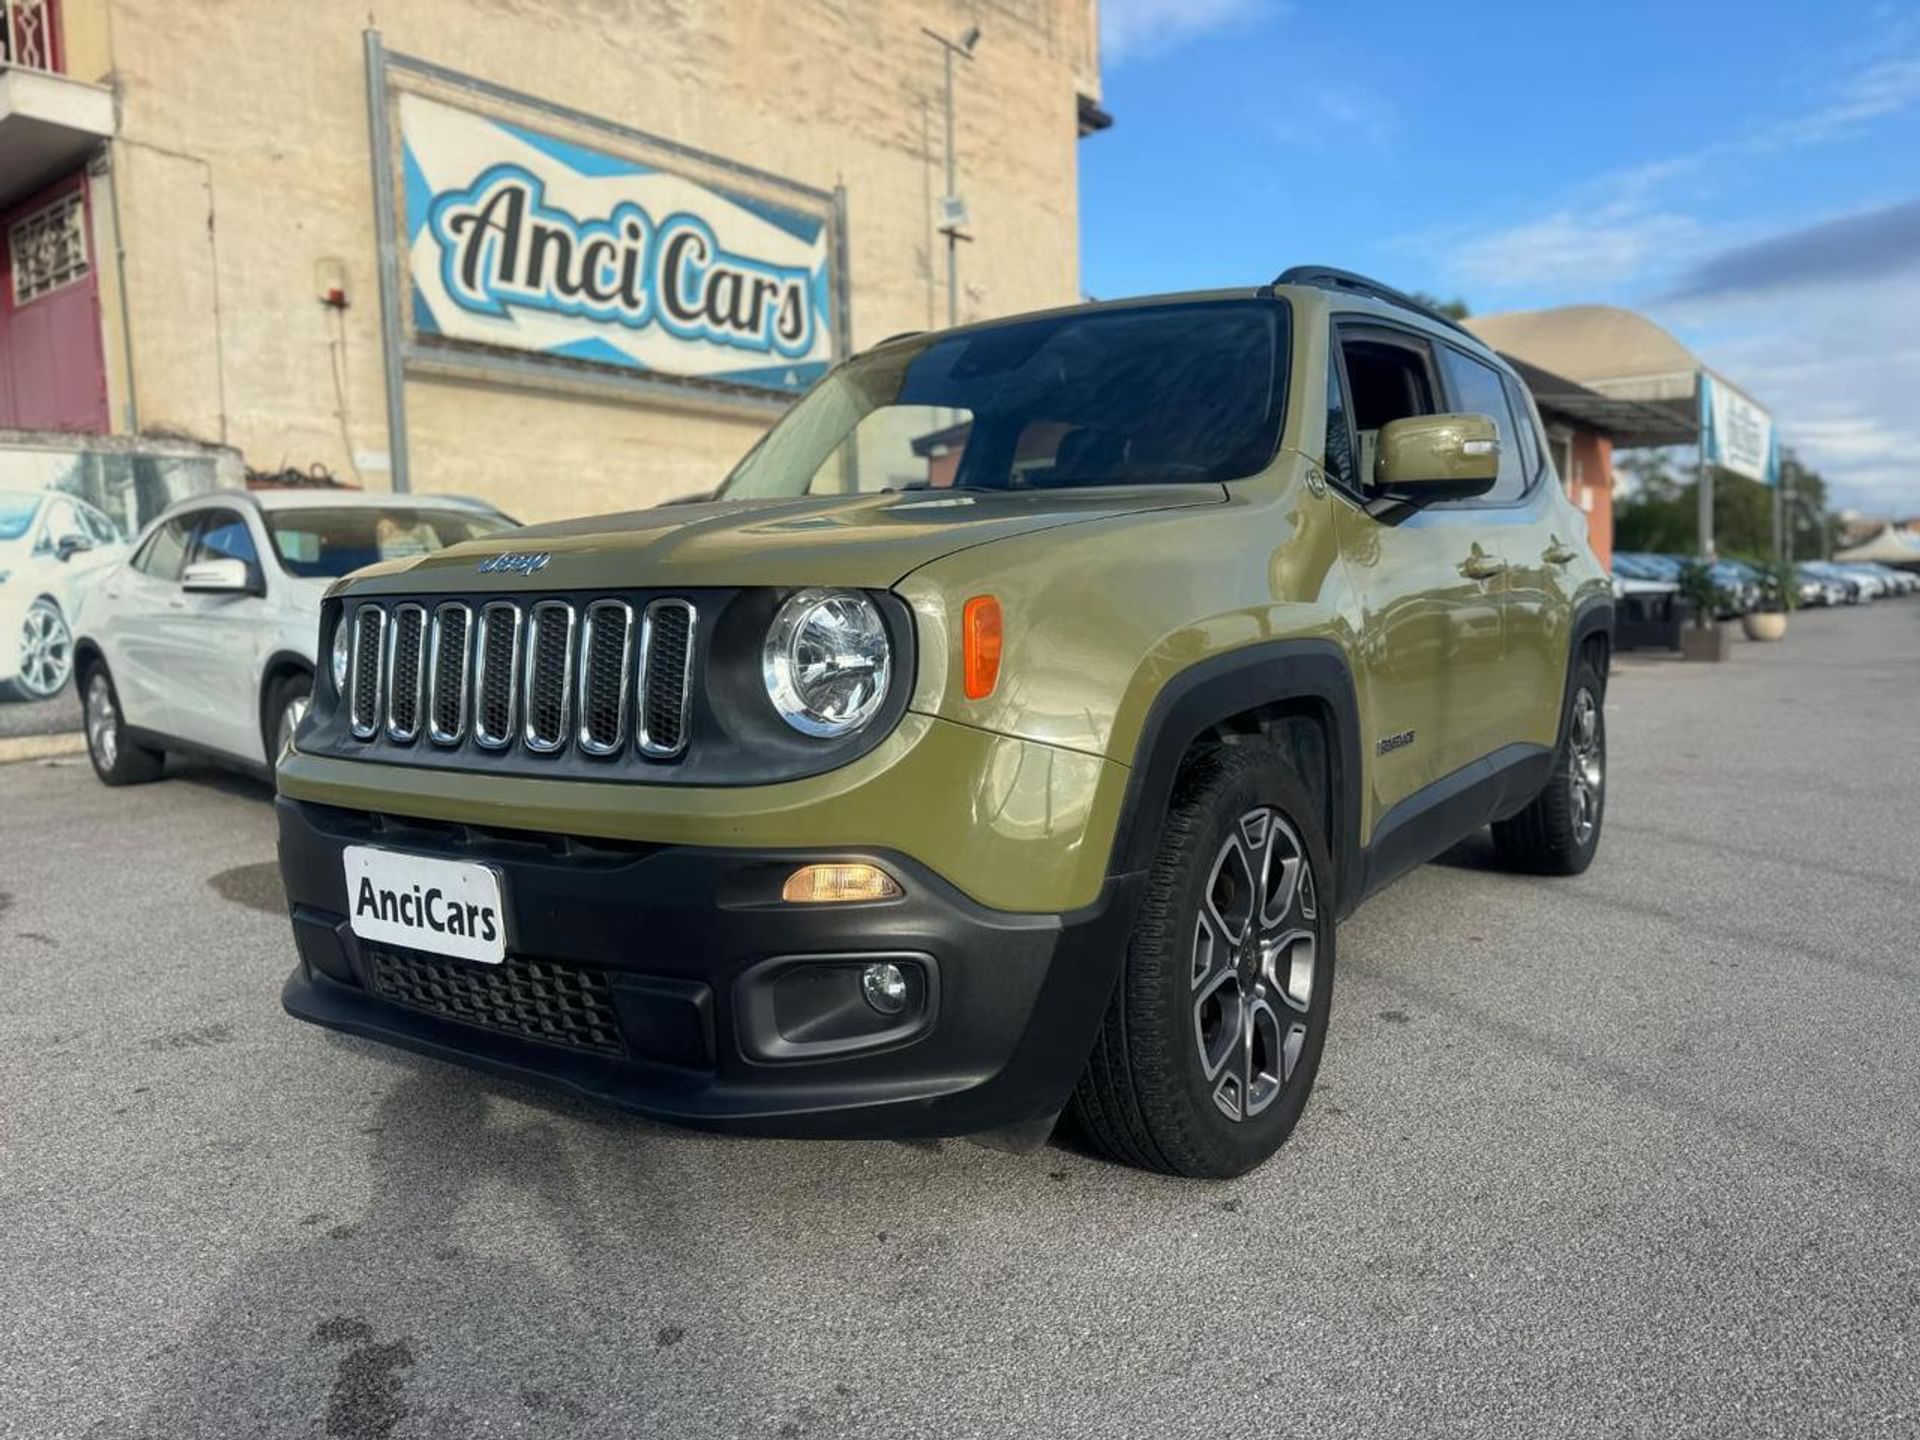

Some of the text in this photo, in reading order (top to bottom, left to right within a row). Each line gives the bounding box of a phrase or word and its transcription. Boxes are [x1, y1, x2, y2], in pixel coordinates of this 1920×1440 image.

[449, 185, 804, 342] Anci Cars
[356, 876, 497, 942] AnciCars
